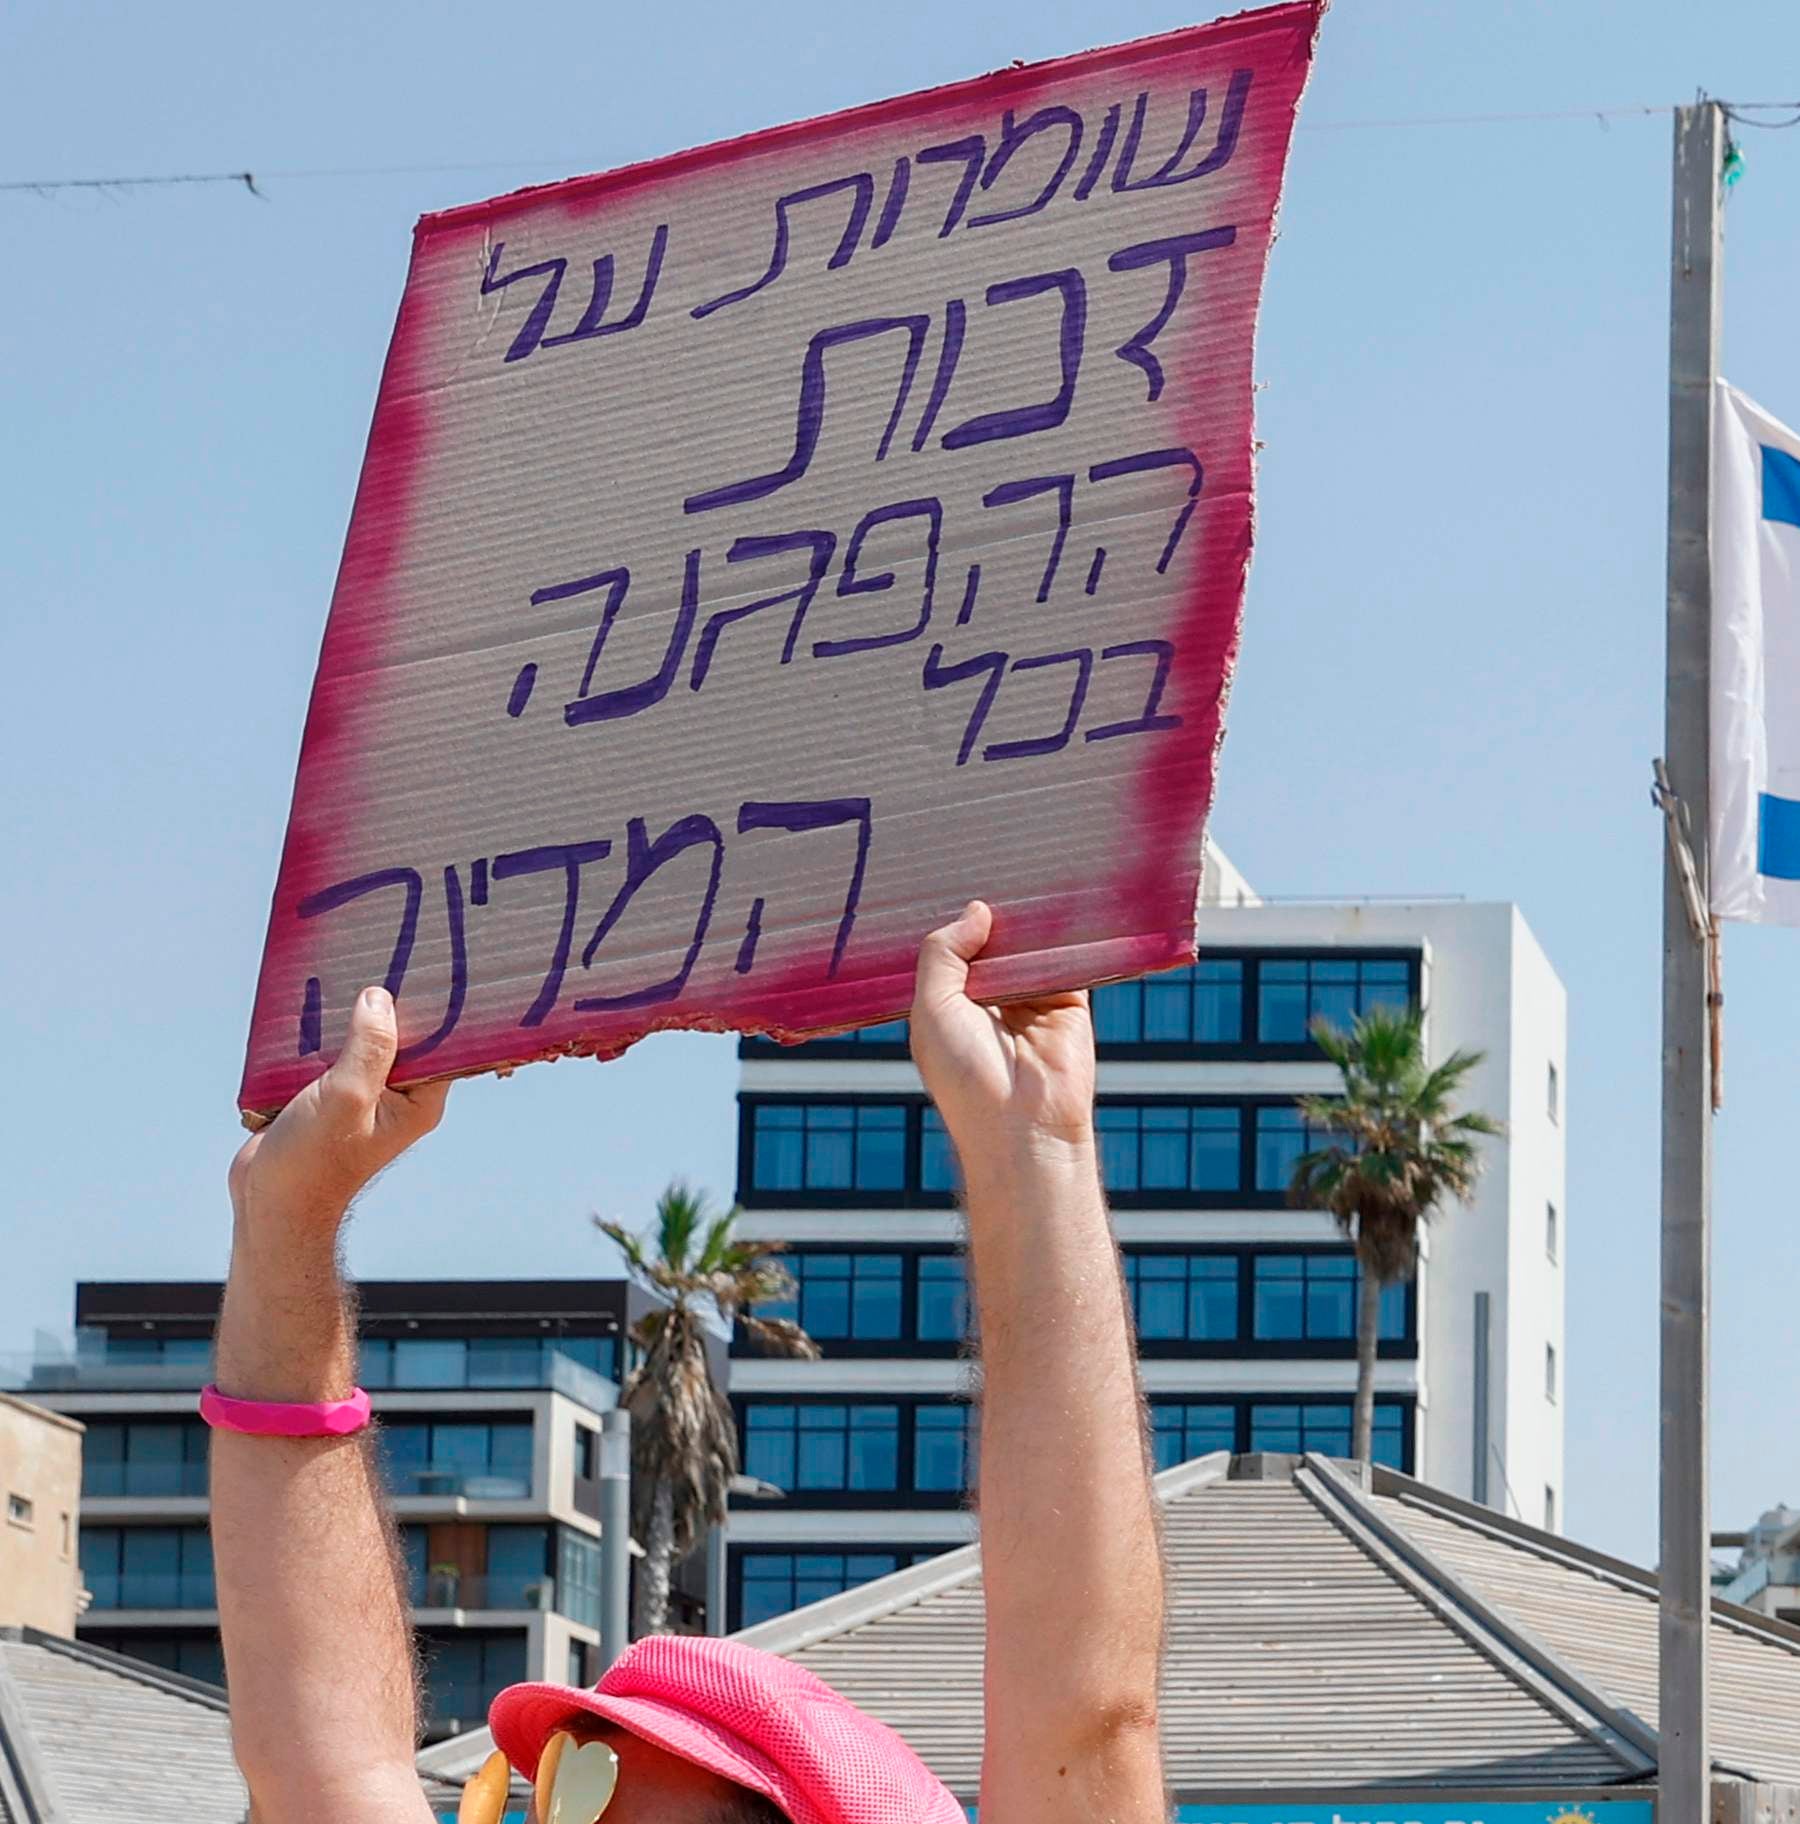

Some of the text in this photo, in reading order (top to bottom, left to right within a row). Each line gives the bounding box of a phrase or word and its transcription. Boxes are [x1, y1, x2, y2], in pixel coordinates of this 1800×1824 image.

[479, 68, 1255, 363] שומרות על
[683, 225, 1237, 514] זכות
[507, 447, 1204, 727] ההפגנה
[922, 639, 1182, 767] בכל
[297, 797, 872, 1060] המדינה
